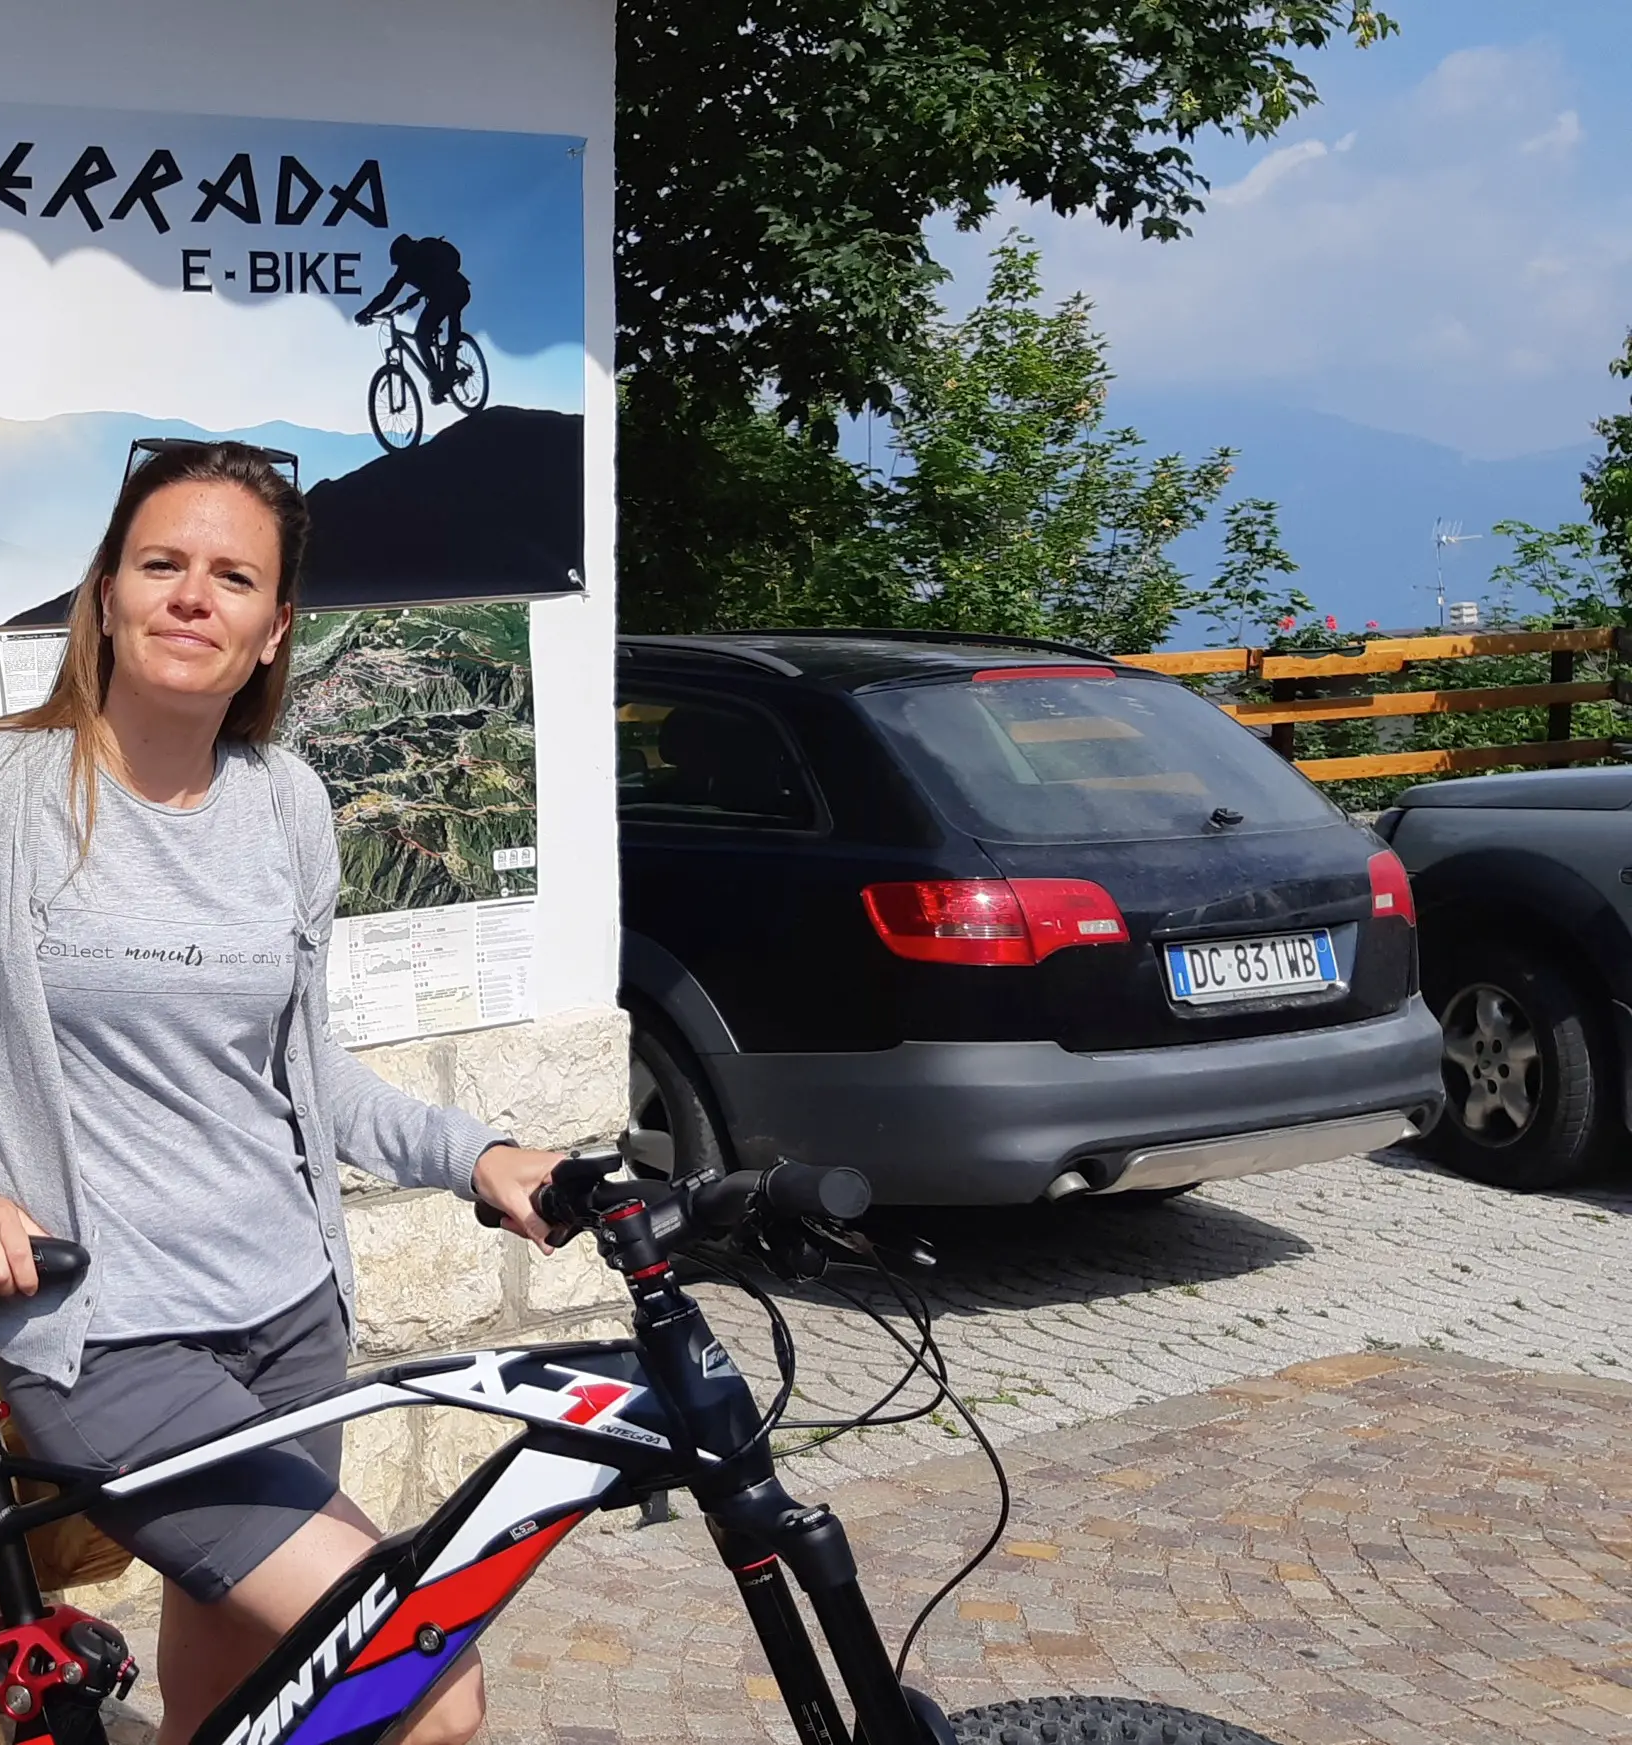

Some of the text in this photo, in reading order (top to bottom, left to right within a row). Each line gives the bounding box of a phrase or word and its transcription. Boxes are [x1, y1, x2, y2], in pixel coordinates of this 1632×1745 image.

[39, 943, 115, 959] collect
[124, 943, 206, 967] moments
[218, 952, 246, 965] not
[252, 951, 282, 968] only
[597, 1423, 662, 1445] INTEGRA
